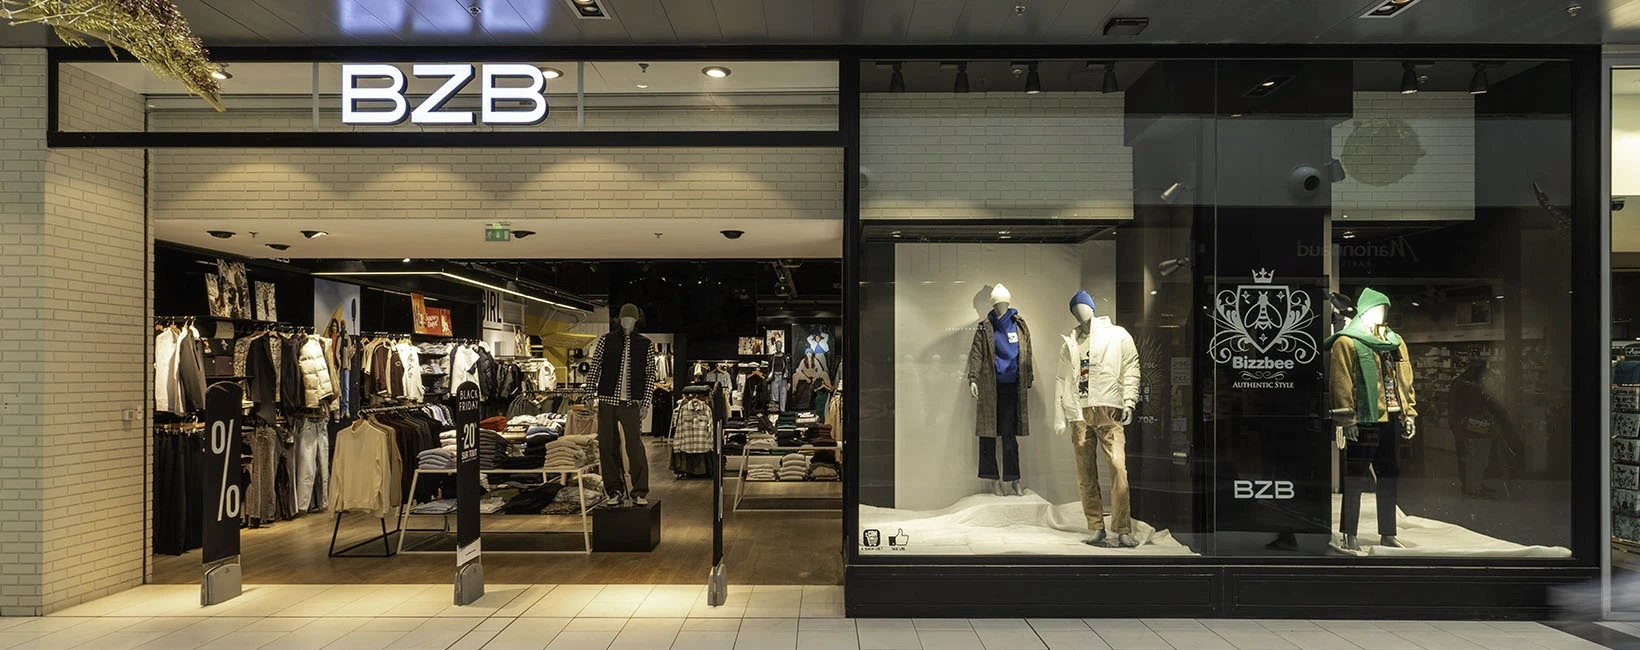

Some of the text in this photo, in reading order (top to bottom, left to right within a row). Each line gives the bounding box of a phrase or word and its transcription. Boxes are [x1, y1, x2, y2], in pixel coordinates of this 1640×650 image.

[342, 64, 549, 125] BZB
[1232, 355, 1294, 369] Bizzbee
[1232, 381, 1294, 389] AUTHENTIC STYLE
[460, 389, 479, 400] BLACK
[458, 400, 479, 412] FRIDAY
[1234, 480, 1295, 499] BZB
